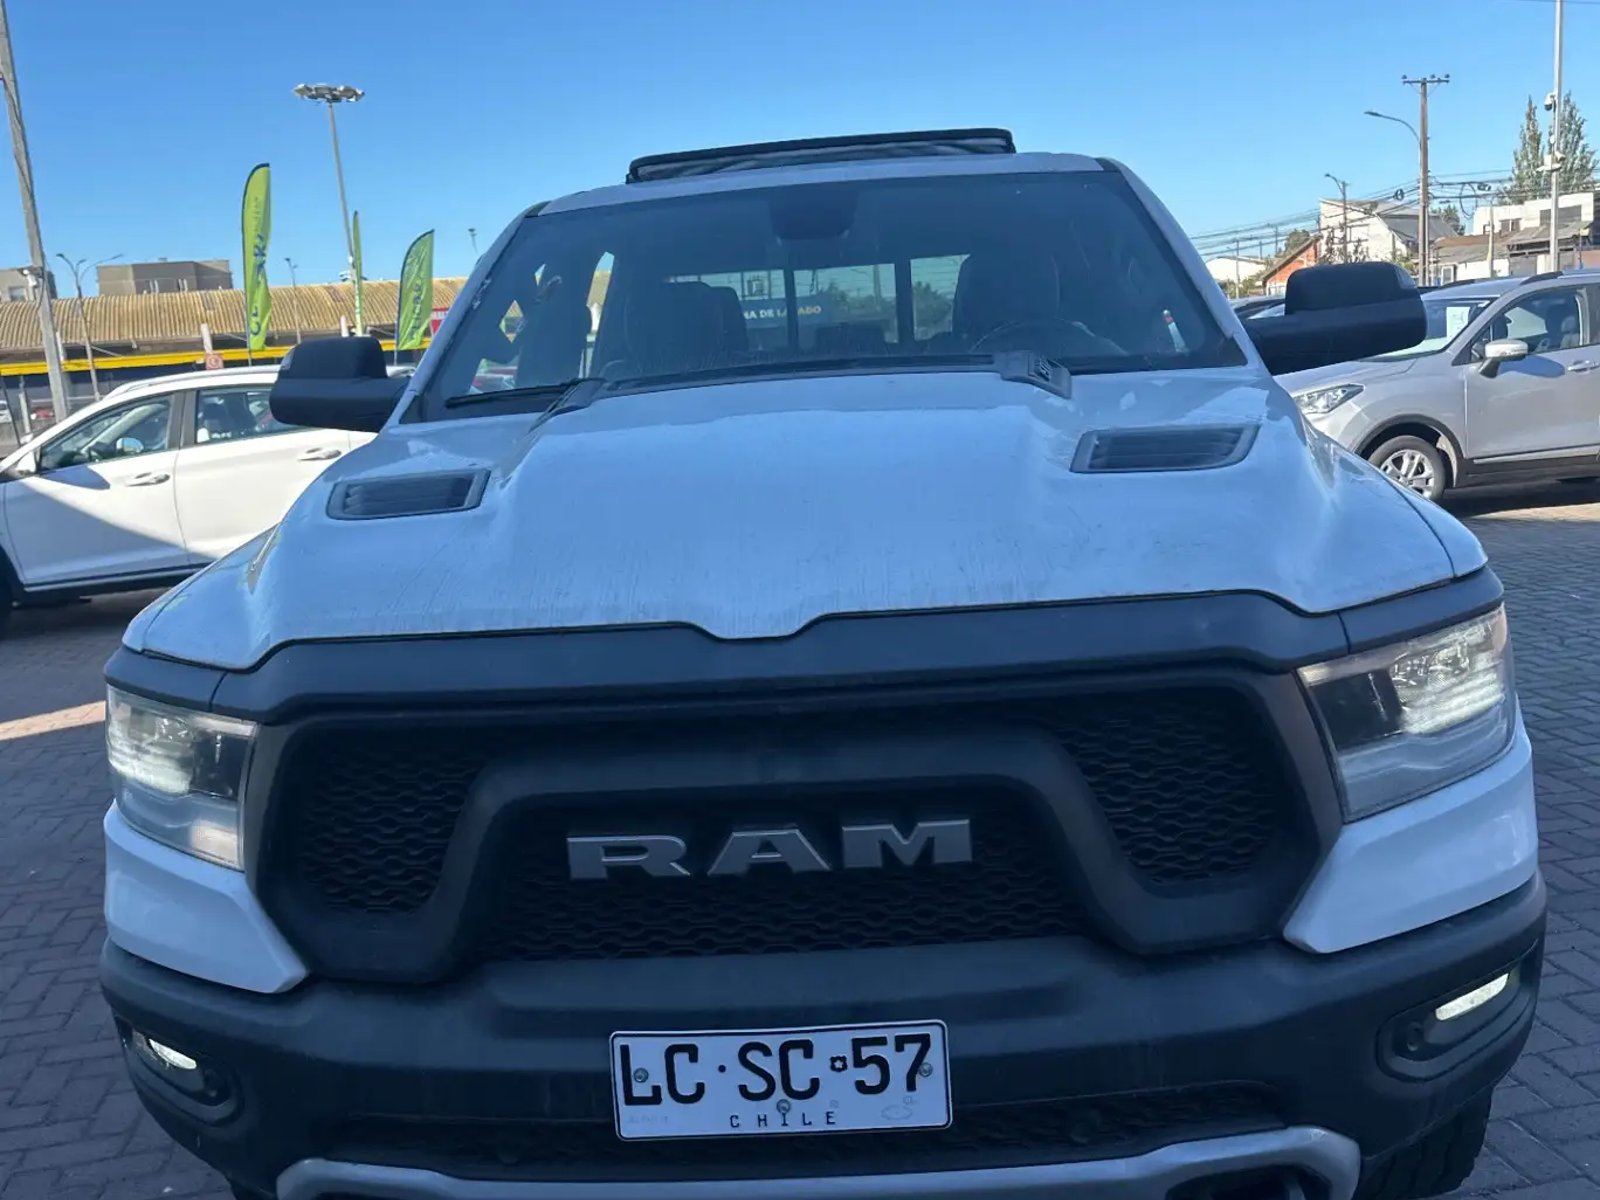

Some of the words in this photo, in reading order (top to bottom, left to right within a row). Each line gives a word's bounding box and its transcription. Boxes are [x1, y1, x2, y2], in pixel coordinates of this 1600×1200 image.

[776, 305, 822, 318] LAADO
[566, 818, 974, 881] RAM
[729, 1110, 837, 1129] CHILE
